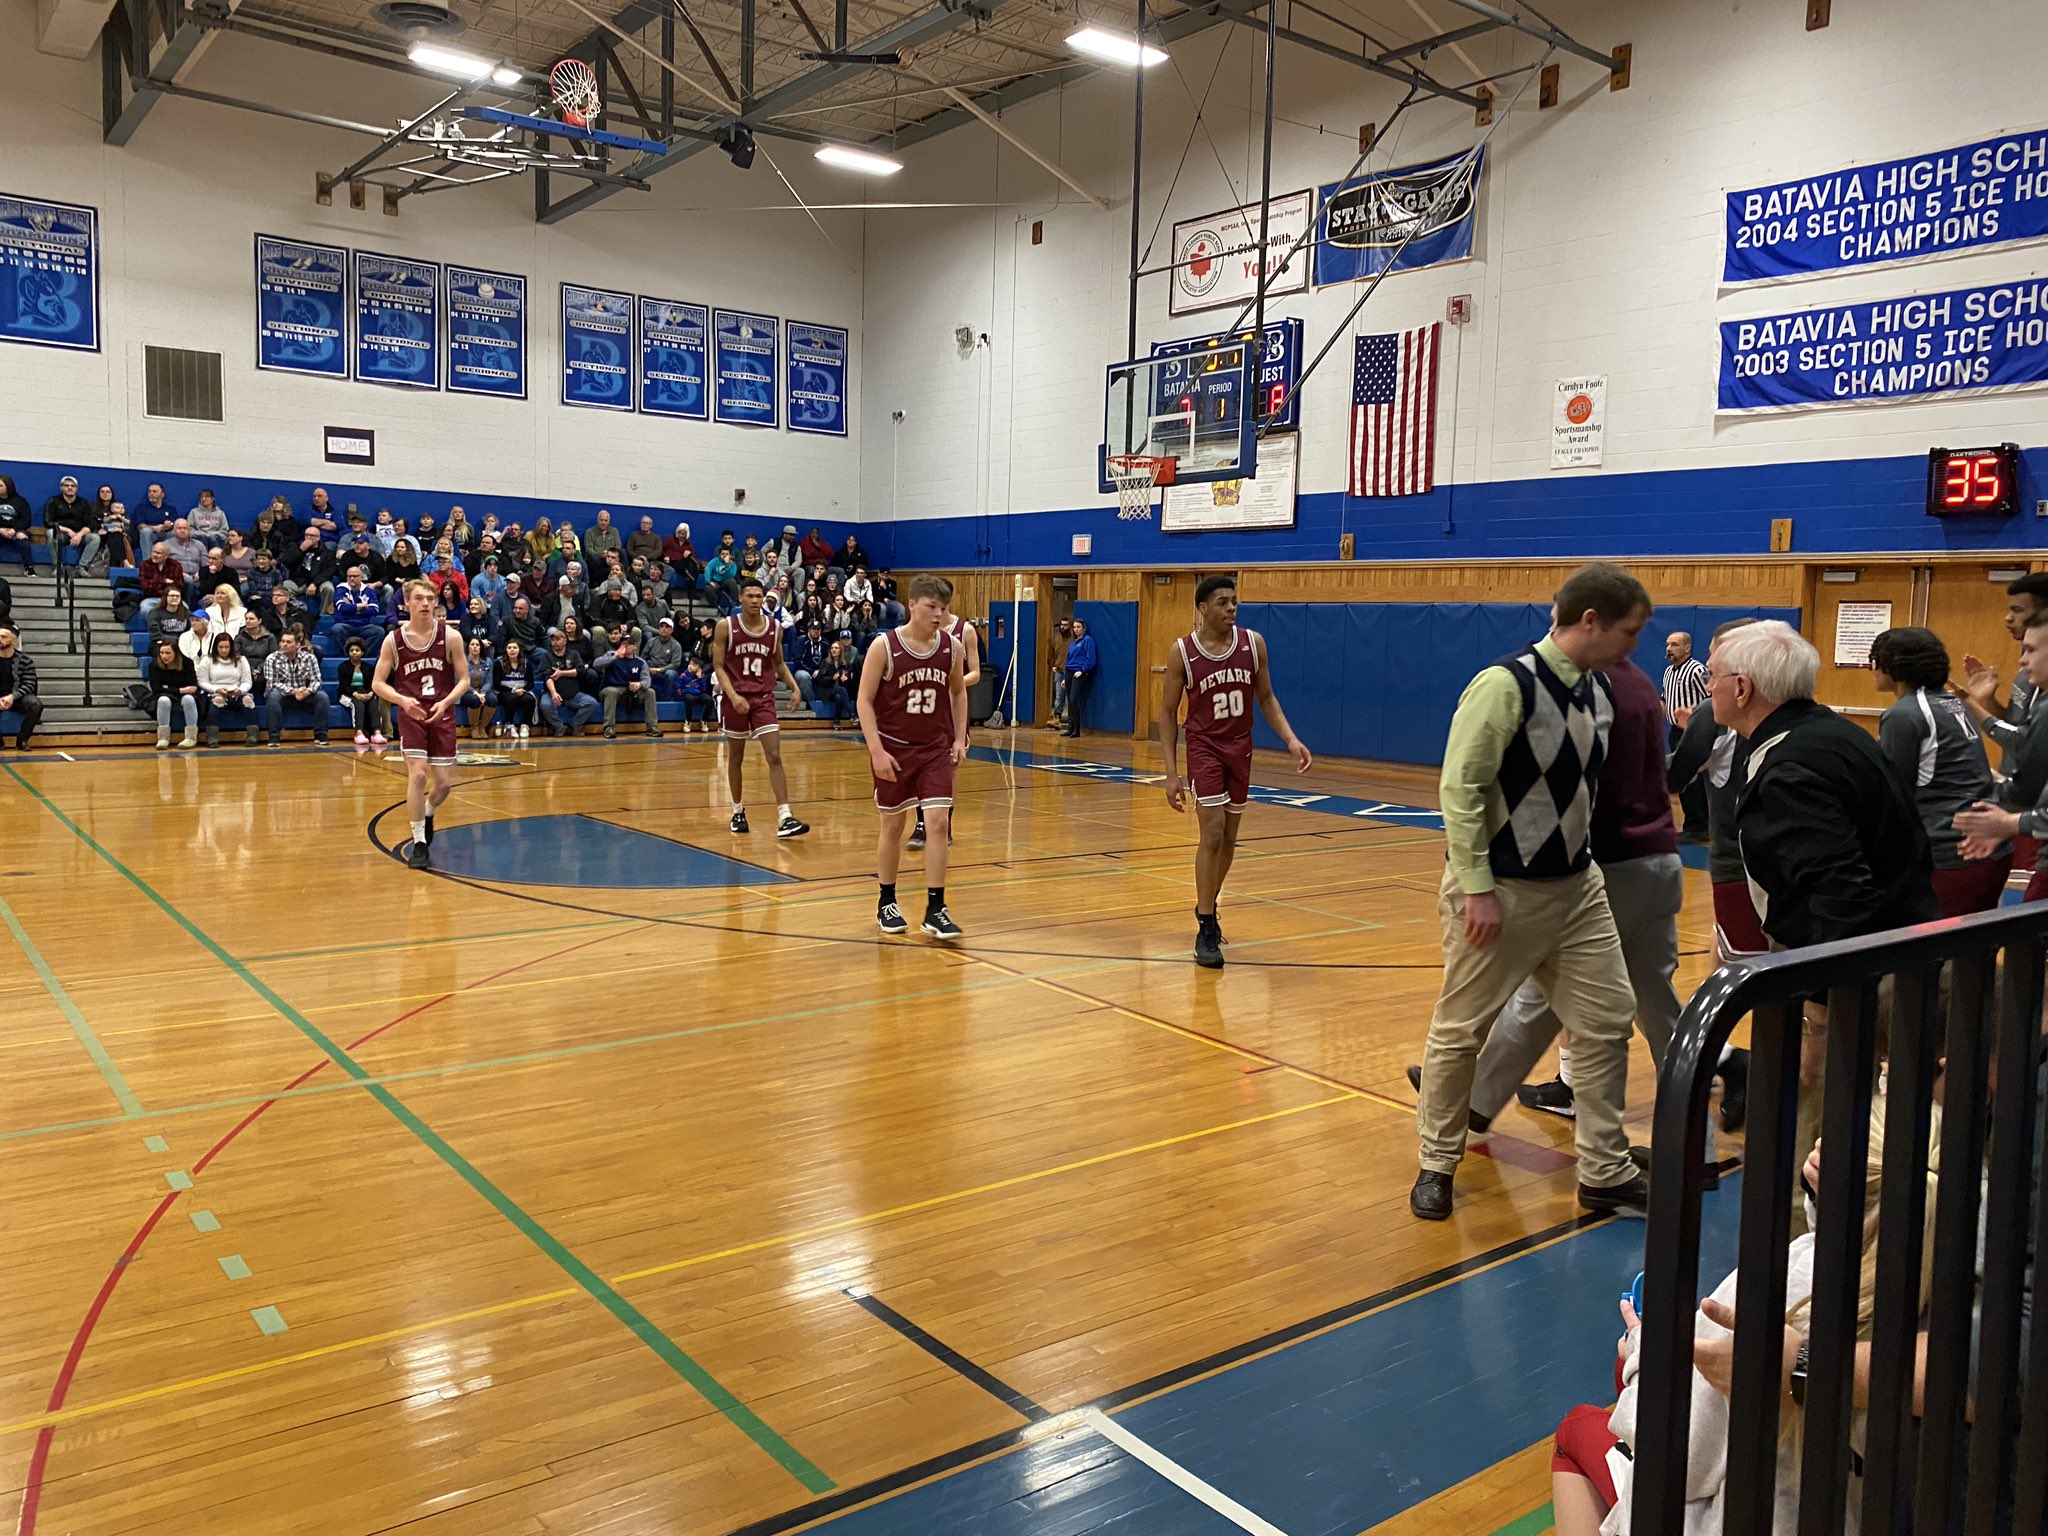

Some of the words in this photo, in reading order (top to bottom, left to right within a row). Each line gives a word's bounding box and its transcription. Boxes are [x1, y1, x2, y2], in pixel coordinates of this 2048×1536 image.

[1744, 174, 1864, 222] BATAVIA
[1876, 155, 1959, 197] HIGH
[1284, 208, 1302, 218] Program
[1332, 201, 1380, 228] STAY
[1735, 218, 1798, 249] 2004
[1806, 196, 1915, 238] SECTION
[1926, 191, 1942, 217] 5
[1950, 178, 2006, 213] ICE
[1839, 210, 2000, 260] CHAMPIONS
[2, 238, 85, 255] SECTIONAL
[263, 262, 341, 284] CHAMPIONS
[274, 277, 331, 290] DIVISION
[361, 278, 432, 298] CHAMPIONS
[452, 272, 520, 298] SOFTBALL
[370, 292, 423, 304] DIVISION
[452, 291, 520, 310] CHAMPIONS
[461, 305, 511, 316] DIVISION
[567, 308, 629, 327] CHAMPIONS
[672, 307, 703, 326] TENNIS
[270, 322, 335, 336] SECTIONAL
[575, 321, 620, 332] DIVISION
[645, 320, 702, 337] CHAMPIONS
[1737, 311, 1856, 351] BATAVIA
[1870, 296, 1951, 334] HIGH
[367, 336, 427, 348] SECTIONAL
[458, 336, 515, 347] SECTIONAL
[653, 333, 695, 343] DIVISION
[720, 332, 773, 348] CHAMPIONS
[791, 326, 843, 346] WRESTLING
[727, 344, 766, 353] DIVISION
[792, 343, 842, 359] CHAMPIONS
[1734, 354, 1789, 378] 2003
[1799, 336, 1904, 371] SECTION
[1916, 334, 1931, 358] 5
[1944, 324, 1996, 356] ICE
[572, 362, 624, 373] SECTIONAL
[799, 355, 836, 364] DIVISION
[461, 367, 512, 377] REGIONAL
[649, 372, 699, 382] SECTIONAL
[724, 372, 769, 382] SECTIONAL
[1251, 365, 1284, 384] UEST
[1834, 356, 1990, 396] CHAMPIONS
[1208, 382, 1232, 394] PERIOD
[1558, 382, 1584, 393] Carolyn
[1586, 380, 1603, 389] Foote
[794, 391, 838, 401] SECTIONAL
[1554, 424, 1602, 436] Sportsmanship
[331, 439, 368, 452] HOME
[1568, 434, 1589, 444] Award
[1946, 458, 1998, 502] 35
[403, 658, 444, 676] NEWARK
[742, 656, 762, 676] 14
[421, 674, 436, 696] 2
[898, 668, 947, 688] NEWARK
[1199, 668, 1251, 694] NEWARK
[906, 688, 937, 714] 23
[1212, 690, 1244, 720] 20
